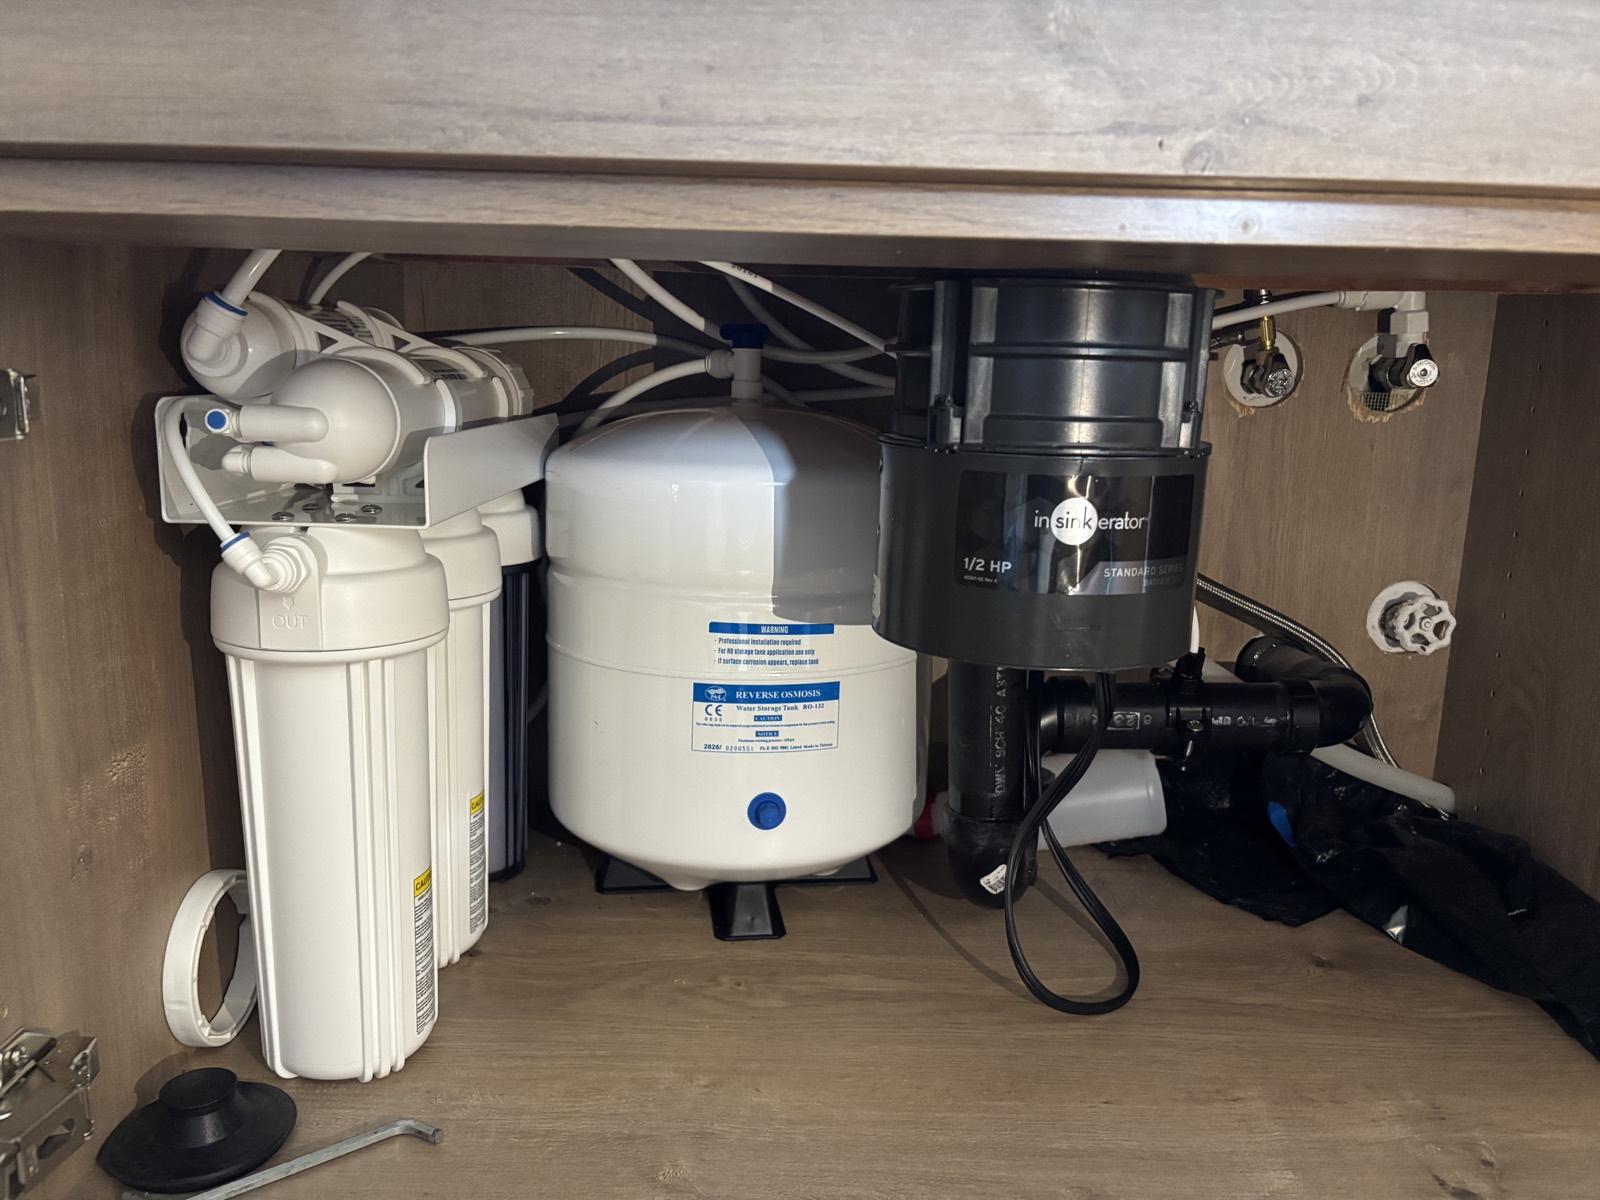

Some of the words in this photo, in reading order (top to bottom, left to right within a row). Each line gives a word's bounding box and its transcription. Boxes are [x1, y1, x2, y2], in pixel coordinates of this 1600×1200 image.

[1034, 506, 1145, 530] insinkerator
[963, 557, 986, 572] 1/2
[990, 560, 1012, 574] HP
[1103, 566, 1157, 578] STANDARD
[271, 614, 308, 630] OUT
[761, 625, 788, 634] WARNING
[718, 637, 750, 646] Professional
[750, 638, 779, 646] installation
[780, 638, 801, 647] required
[734, 648, 754, 657] storage
[755, 648, 766, 656] tank
[766, 649, 795, 658] application
[804, 649, 815, 657] only
[742, 658, 767, 666] corrosion
[767, 659, 789, 667] appears,
[789, 658, 808, 667] replace
[735, 690, 779, 700] REVERSE
[781, 689, 821, 699] OSMOSIS
[757, 704, 782, 713] Storage
[994, 730, 1007, 758] SCH
